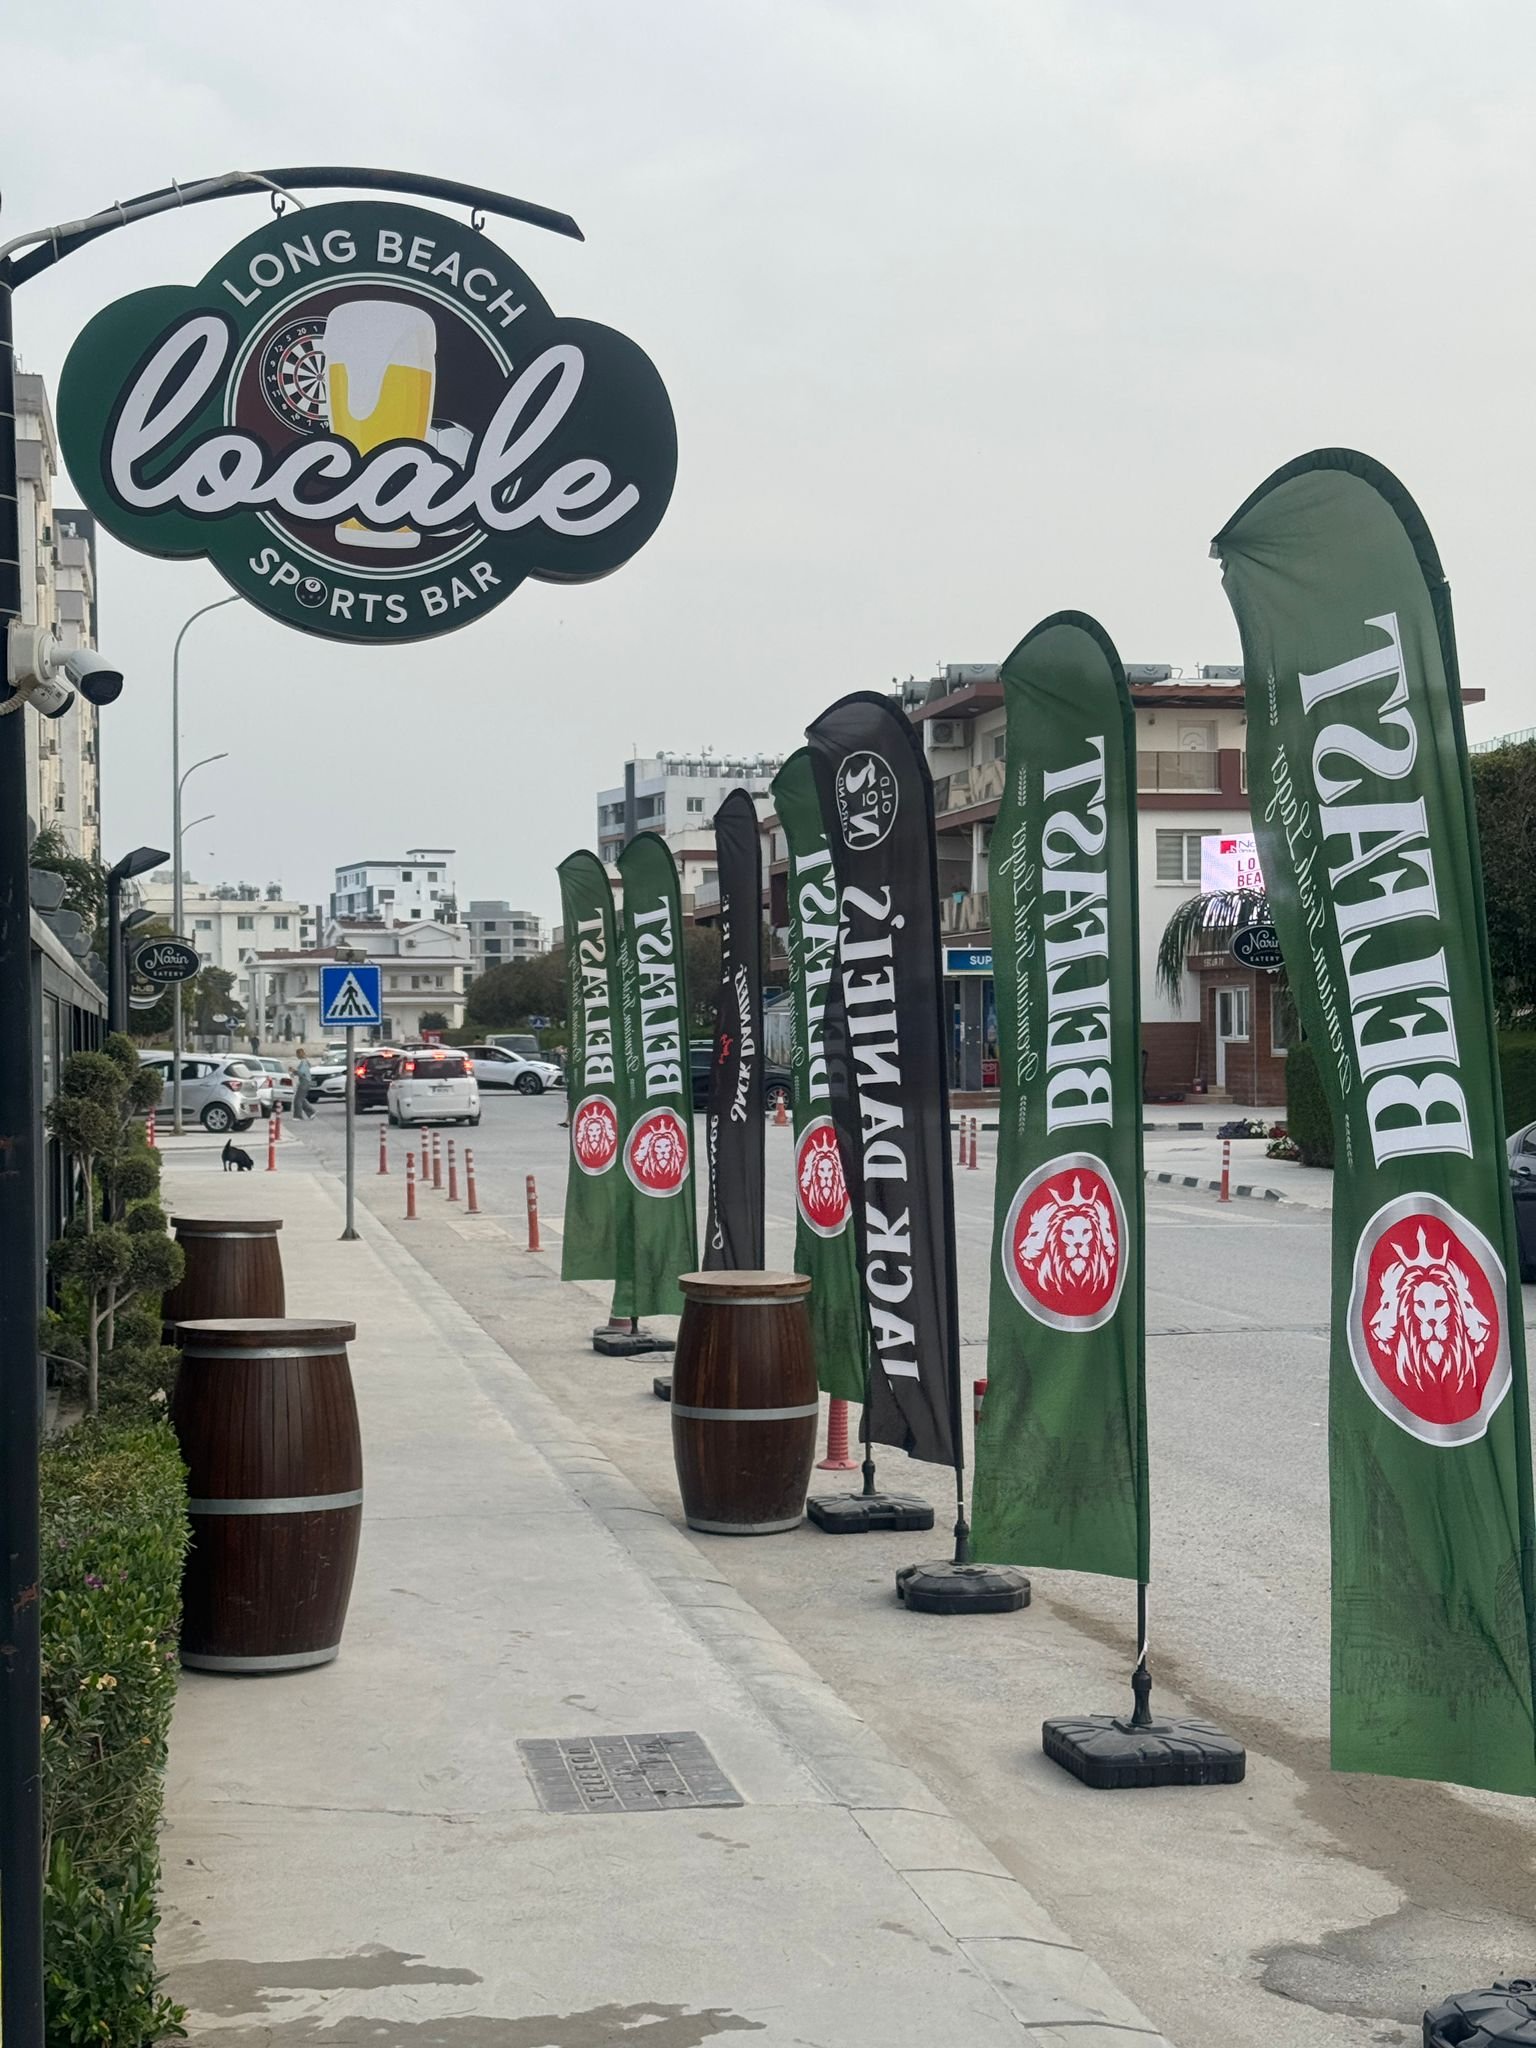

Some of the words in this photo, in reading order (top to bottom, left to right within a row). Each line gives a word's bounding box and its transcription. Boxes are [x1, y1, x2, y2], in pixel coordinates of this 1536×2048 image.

[221, 229, 357, 308] LONG
[377, 230, 527, 329] BEACH
[297, 327, 307, 336] 20
[286, 334, 292, 342] 5
[274, 345, 284, 353] 12
[267, 374, 277, 383] 14
[111, 316, 640, 536] locale
[320, 420, 329, 429] 19
[420, 560, 501, 618] BAR
[1238, 872, 1262, 888] BEA
[145, 946, 189, 969] Narin
[969, 955, 992, 965] SUP
